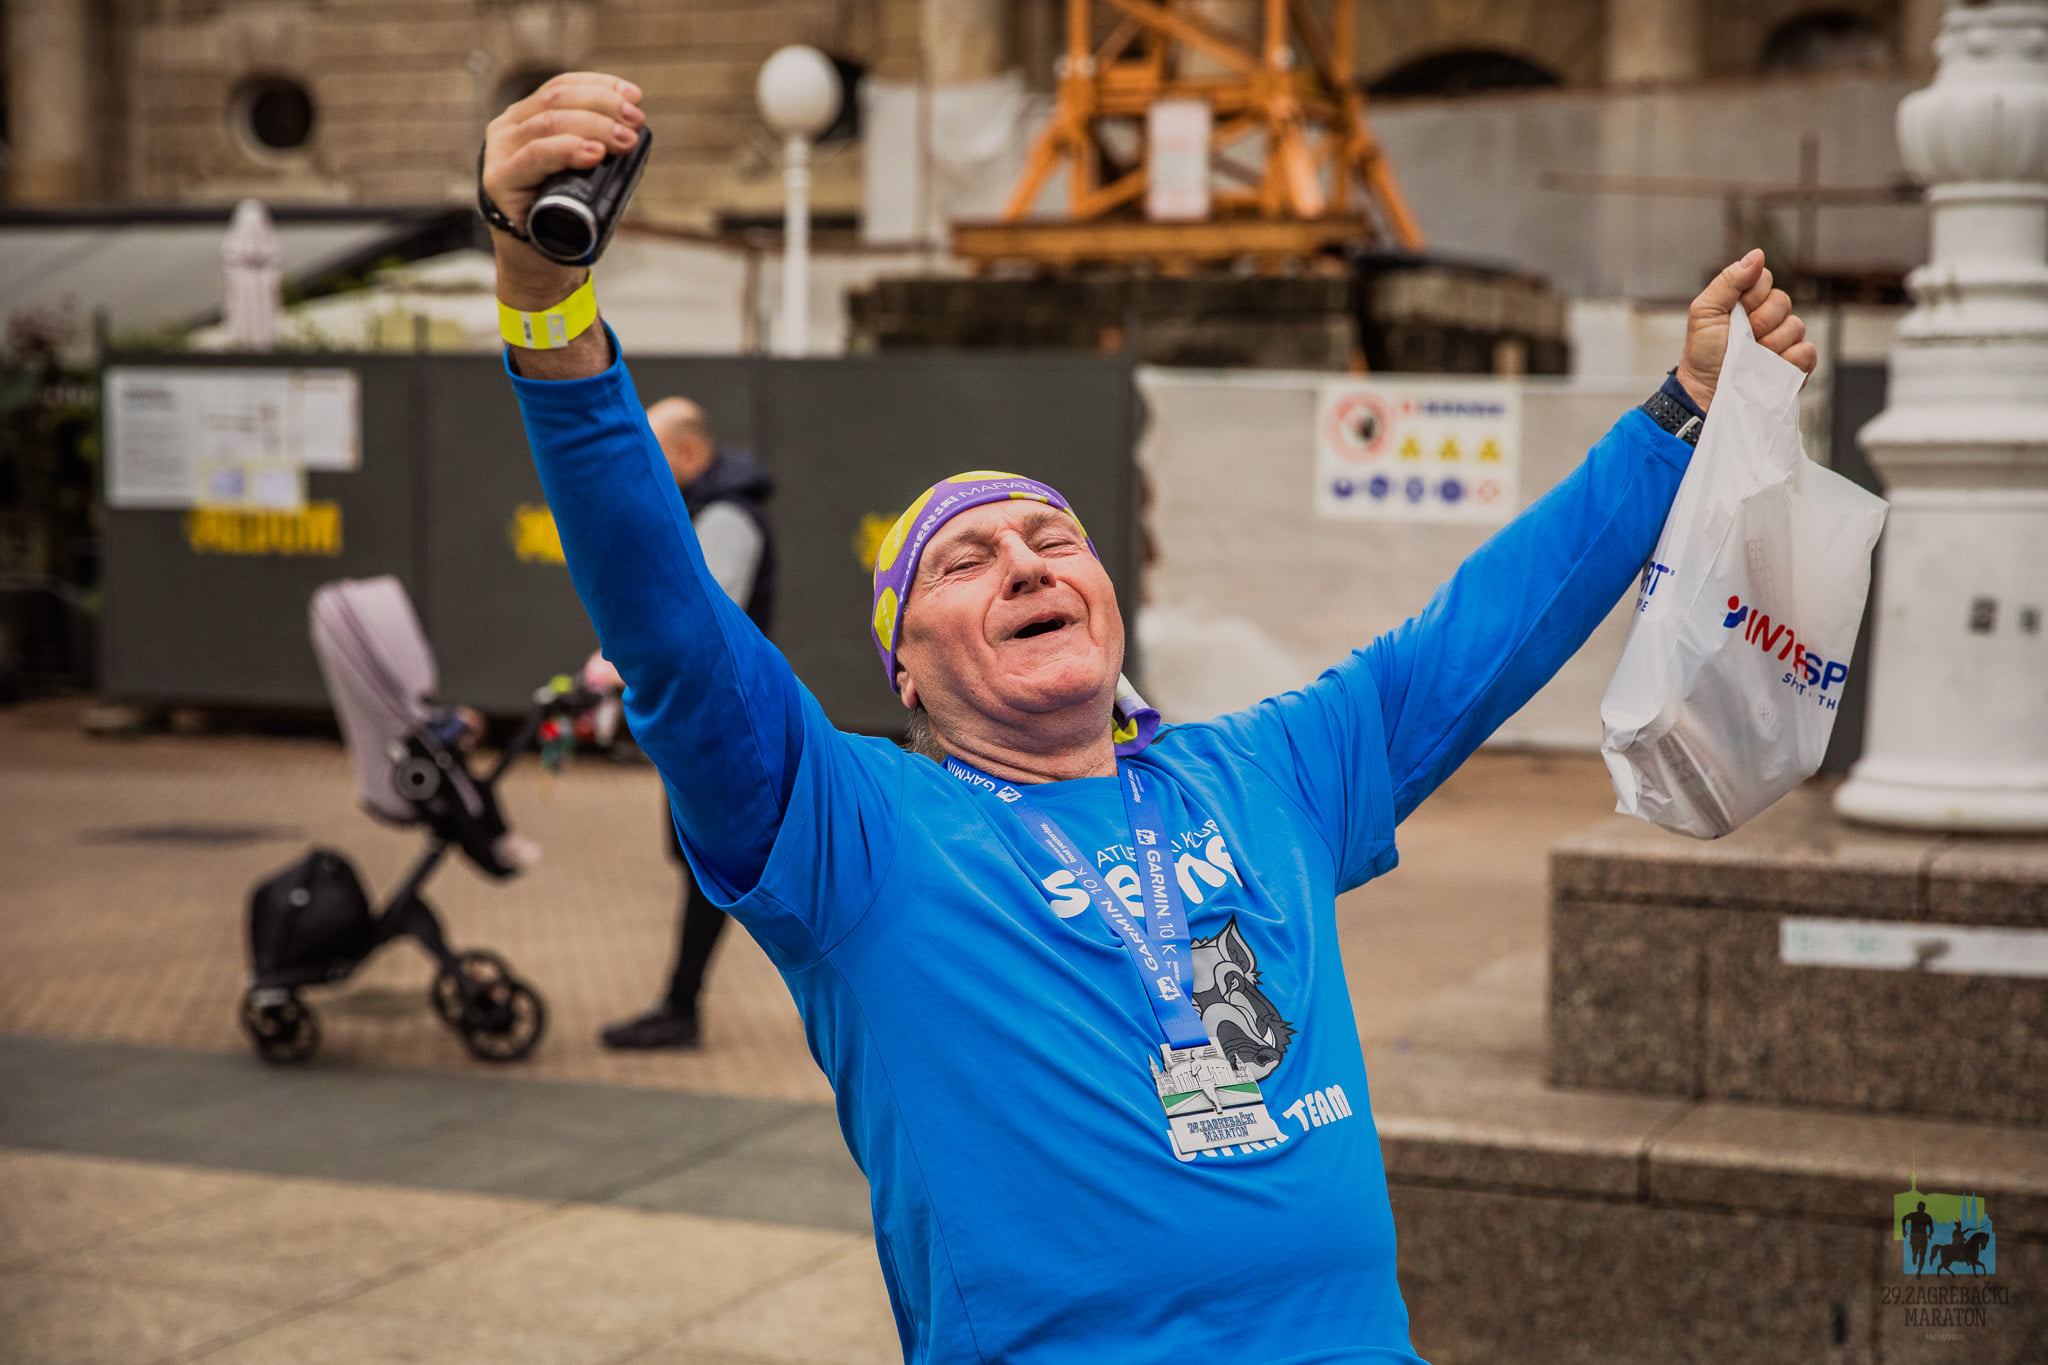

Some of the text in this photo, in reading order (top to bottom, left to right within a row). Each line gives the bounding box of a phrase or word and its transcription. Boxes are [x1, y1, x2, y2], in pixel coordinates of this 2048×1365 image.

[1159, 922, 1176, 939] 10
[1161, 943, 1177, 956] K
[1282, 1084, 1353, 1132] TEAM
[1203, 1126, 1249, 1143] MARATON
